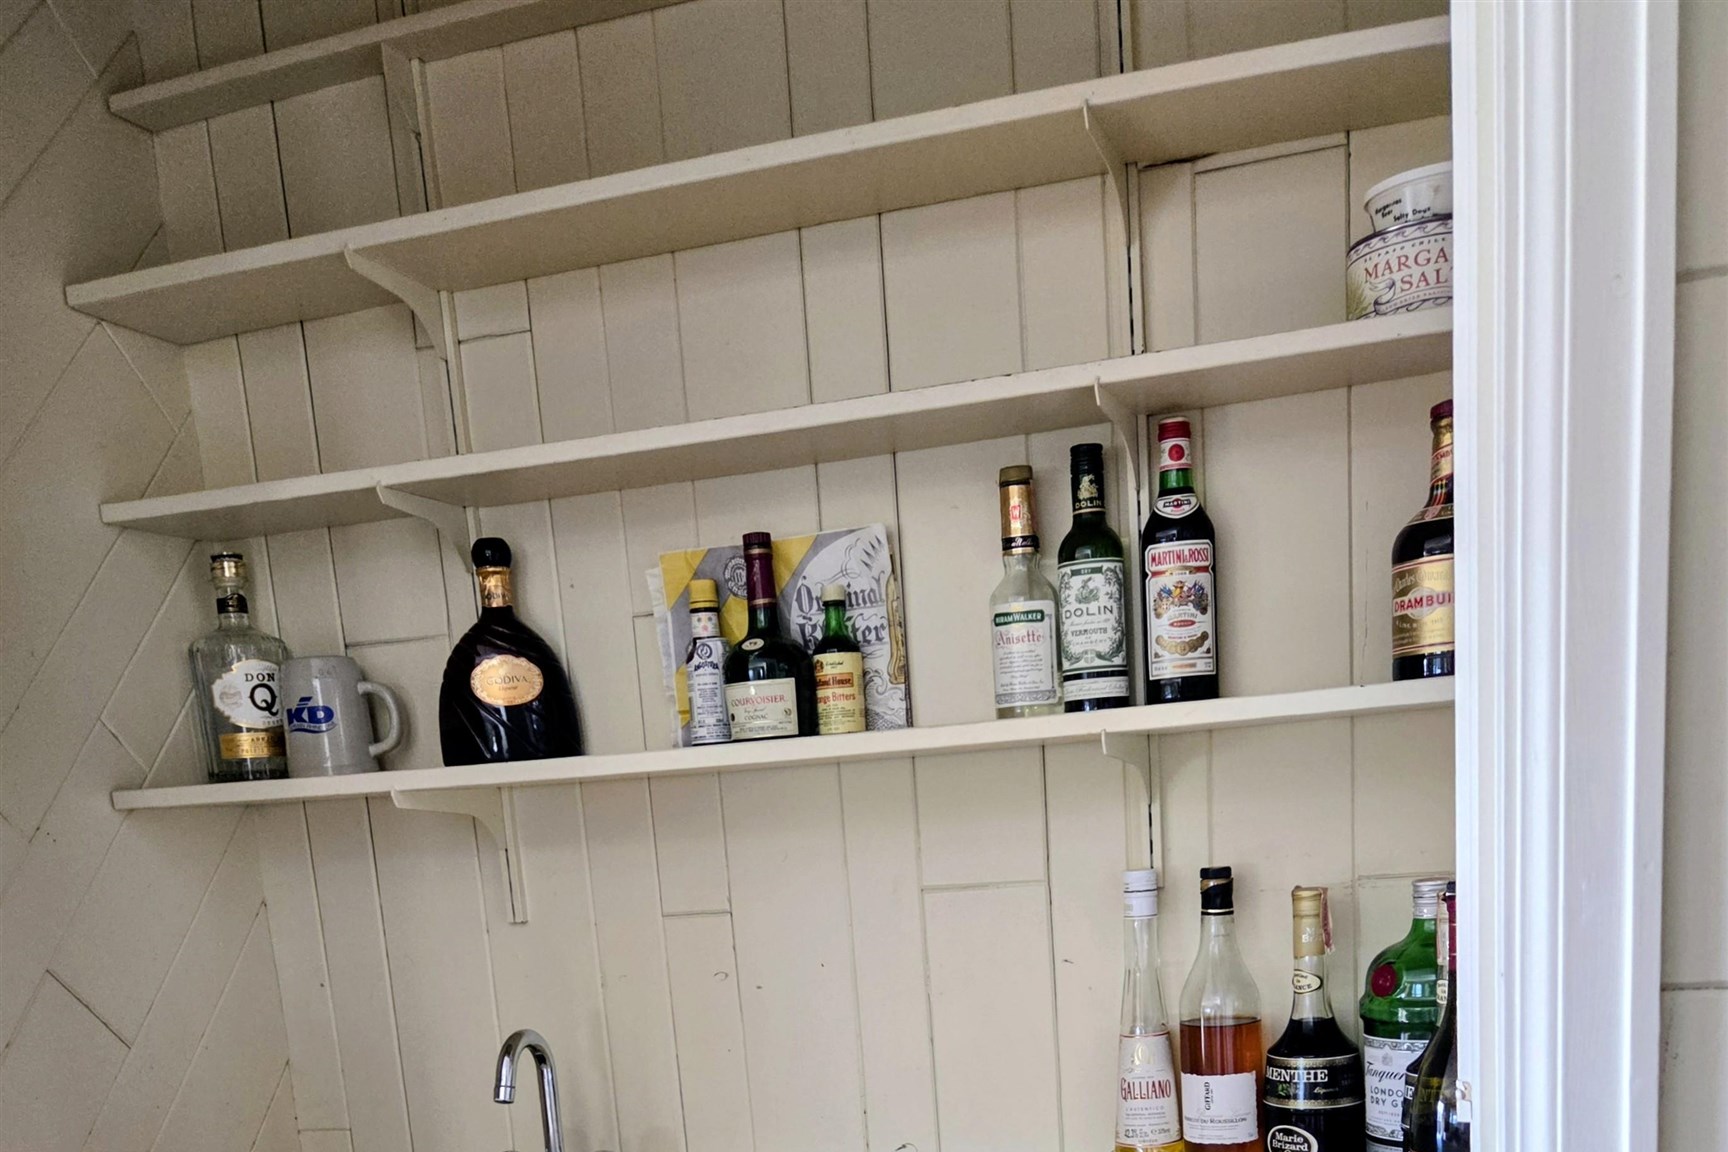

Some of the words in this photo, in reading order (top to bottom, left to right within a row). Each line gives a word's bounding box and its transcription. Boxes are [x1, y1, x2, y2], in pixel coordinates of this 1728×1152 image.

[1364, 246, 1449, 284] MARGA
[1400, 266, 1453, 293] SAL
[1074, 499, 1103, 509] DOLIN
[1164, 499, 1191, 507] MARTINI
[1150, 549, 1184, 568] MARTINI
[1188, 547, 1209, 563] ROSSI
[1394, 592, 1454, 613] DRAMBUI
[995, 615, 1013, 625] HIRAM
[1013, 612, 1042, 622] WALKER
[1065, 605, 1114, 619] DOLIN
[997, 629, 1042, 647] Anisette
[1071, 627, 1108, 637] VERMOUTH
[245, 672, 275, 682] DON
[486, 675, 528, 686] GODIVA
[248, 683, 279, 716] Q
[731, 694, 786, 708] COURVOISIER
[832, 692, 856, 702] Bitters
[744, 713, 769, 721] COGNAC
[1266, 1065, 1328, 1083] MENTHE
[1120, 1076, 1172, 1102] GALLIANO
[1370, 1085, 1404, 1098] LONDO
[1370, 1095, 1387, 1107] DRY
[1275, 1131, 1304, 1143] Marie
[1272, 1139, 1309, 1152] Brizard
